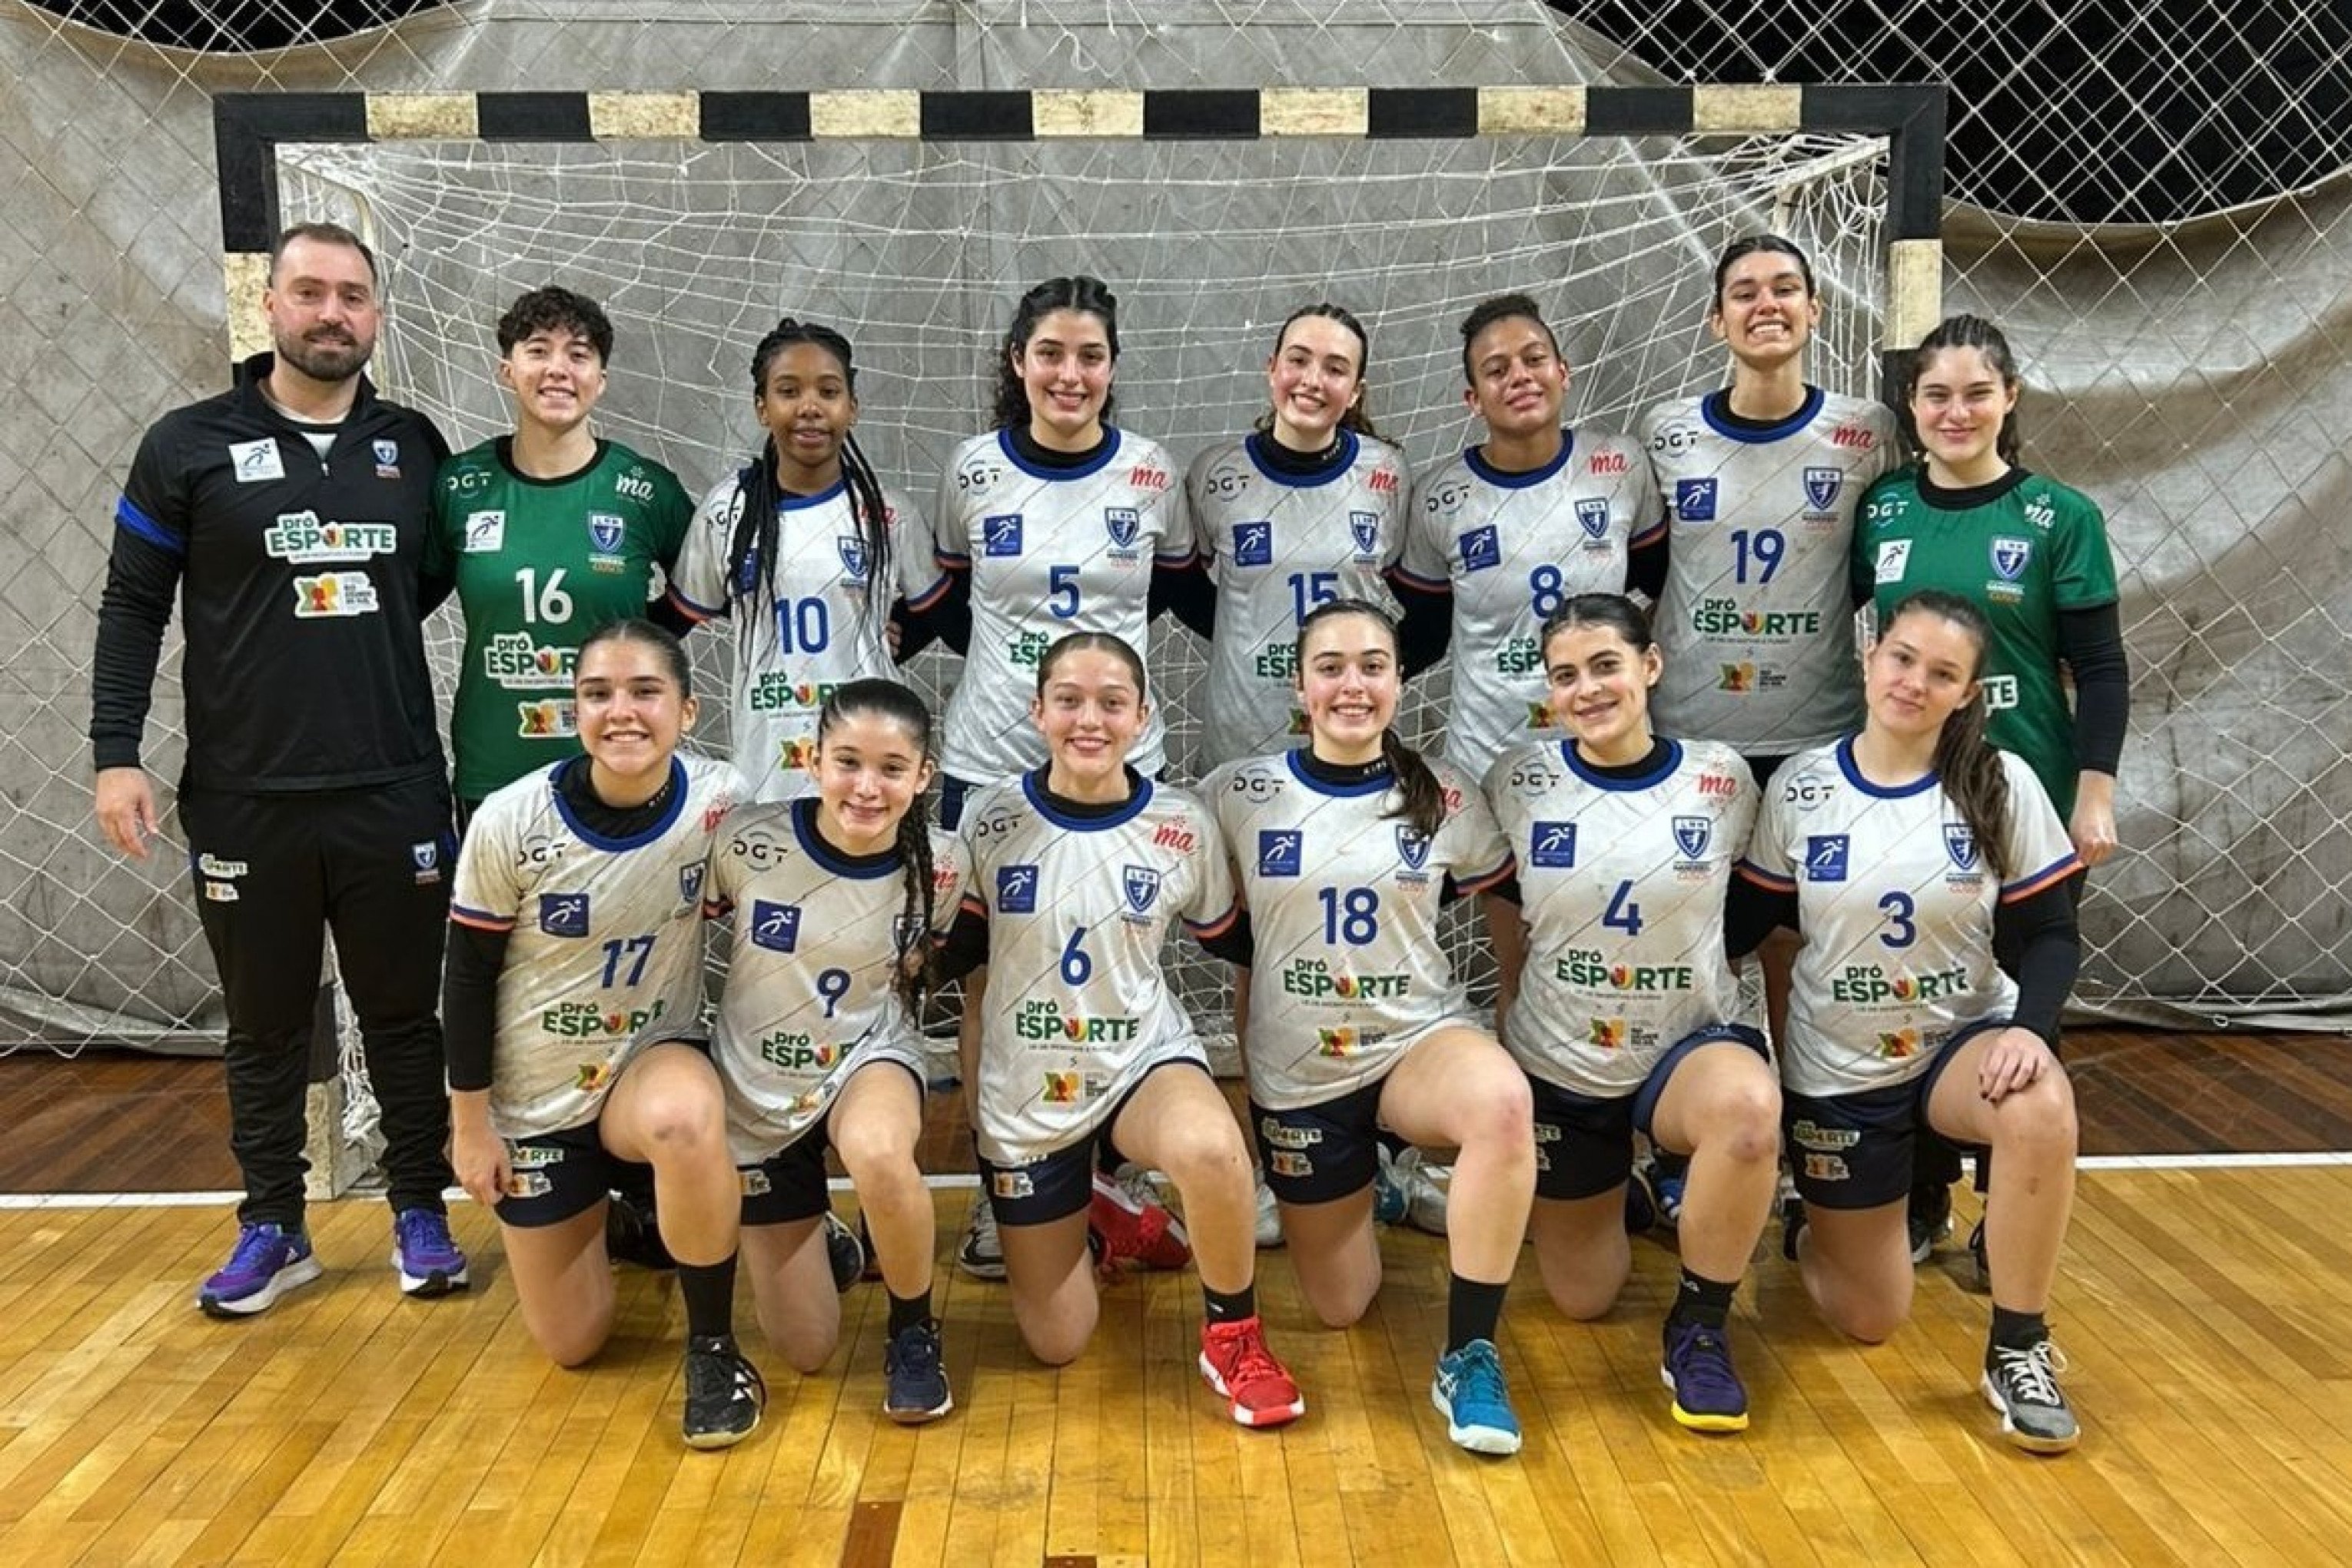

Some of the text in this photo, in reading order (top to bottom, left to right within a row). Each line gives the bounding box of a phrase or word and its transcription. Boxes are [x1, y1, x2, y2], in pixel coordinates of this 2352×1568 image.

[270, 528, 394, 553] ESPORTE
[1731, 530, 1786, 584] 19
[515, 568, 573, 624] 16
[1050, 566, 1080, 619] 5
[1288, 572, 1338, 627] 15
[1530, 565, 1565, 618] 8
[774, 597, 829, 655] 10
[1694, 611, 1819, 635] ESPORTE
[487, 653, 579, 676] ESPOR
[1154, 825, 1197, 852] ma
[1319, 887, 1379, 946] 18
[1603, 879, 1643, 936] 4
[1879, 891, 1917, 948] 3
[603, 935, 657, 989] 17
[1060, 927, 1091, 986] 6
[1556, 958, 1692, 991] ESPORTE
[817, 968, 852, 1018] 9
[1284, 971, 1410, 998] ESPORTE
[1833, 968, 1968, 1002] ESPORTE
[542, 1000, 666, 1038] ESPORT
[1015, 1012, 1139, 1041] ESPORTE
